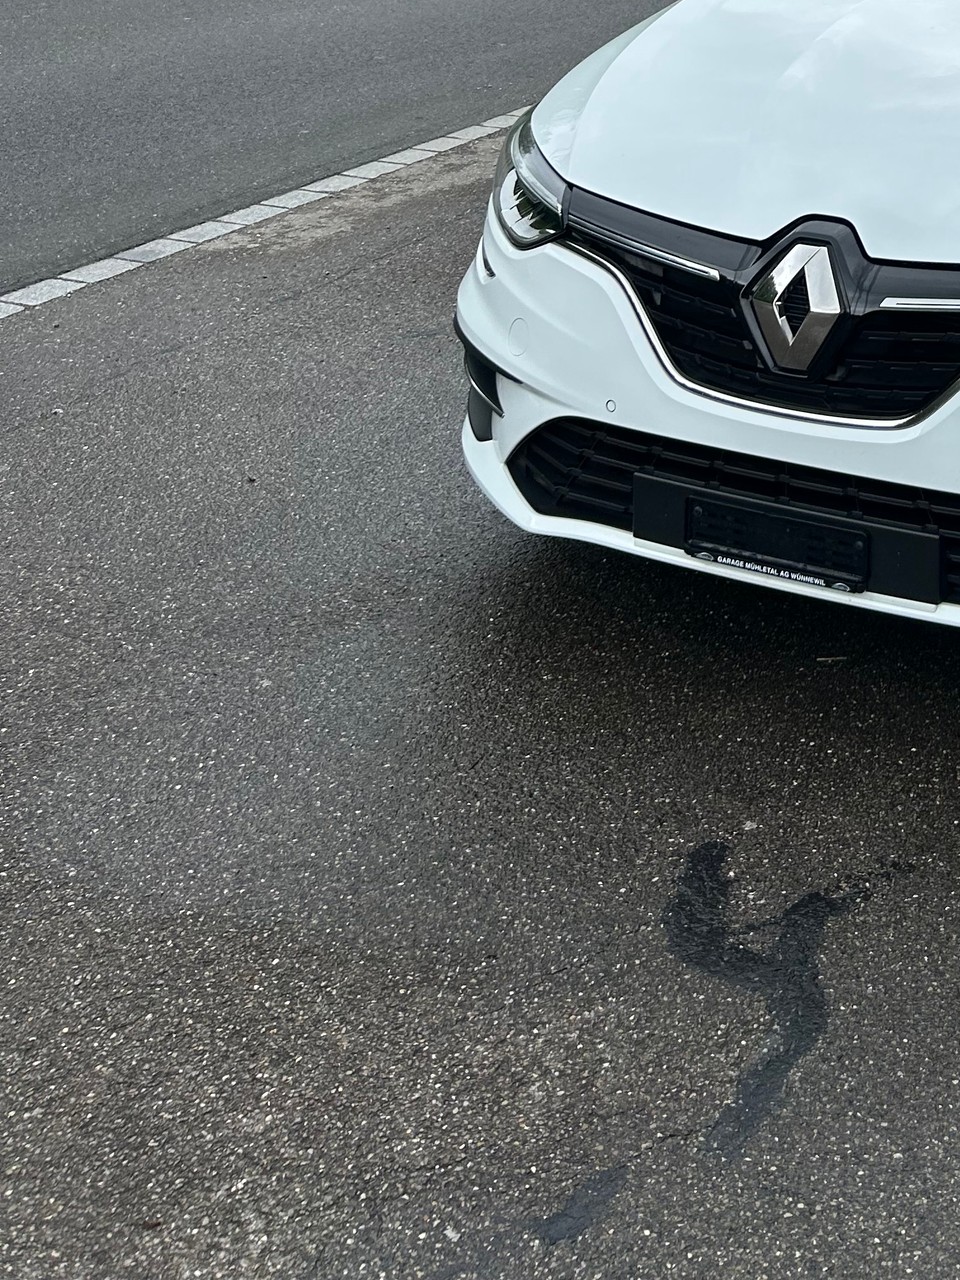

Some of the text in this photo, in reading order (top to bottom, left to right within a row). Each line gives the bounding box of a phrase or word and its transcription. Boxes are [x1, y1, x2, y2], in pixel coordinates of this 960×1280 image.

[717, 555, 826, 586] GARAGE MÜHLETAL AG WÜNNEWIL
